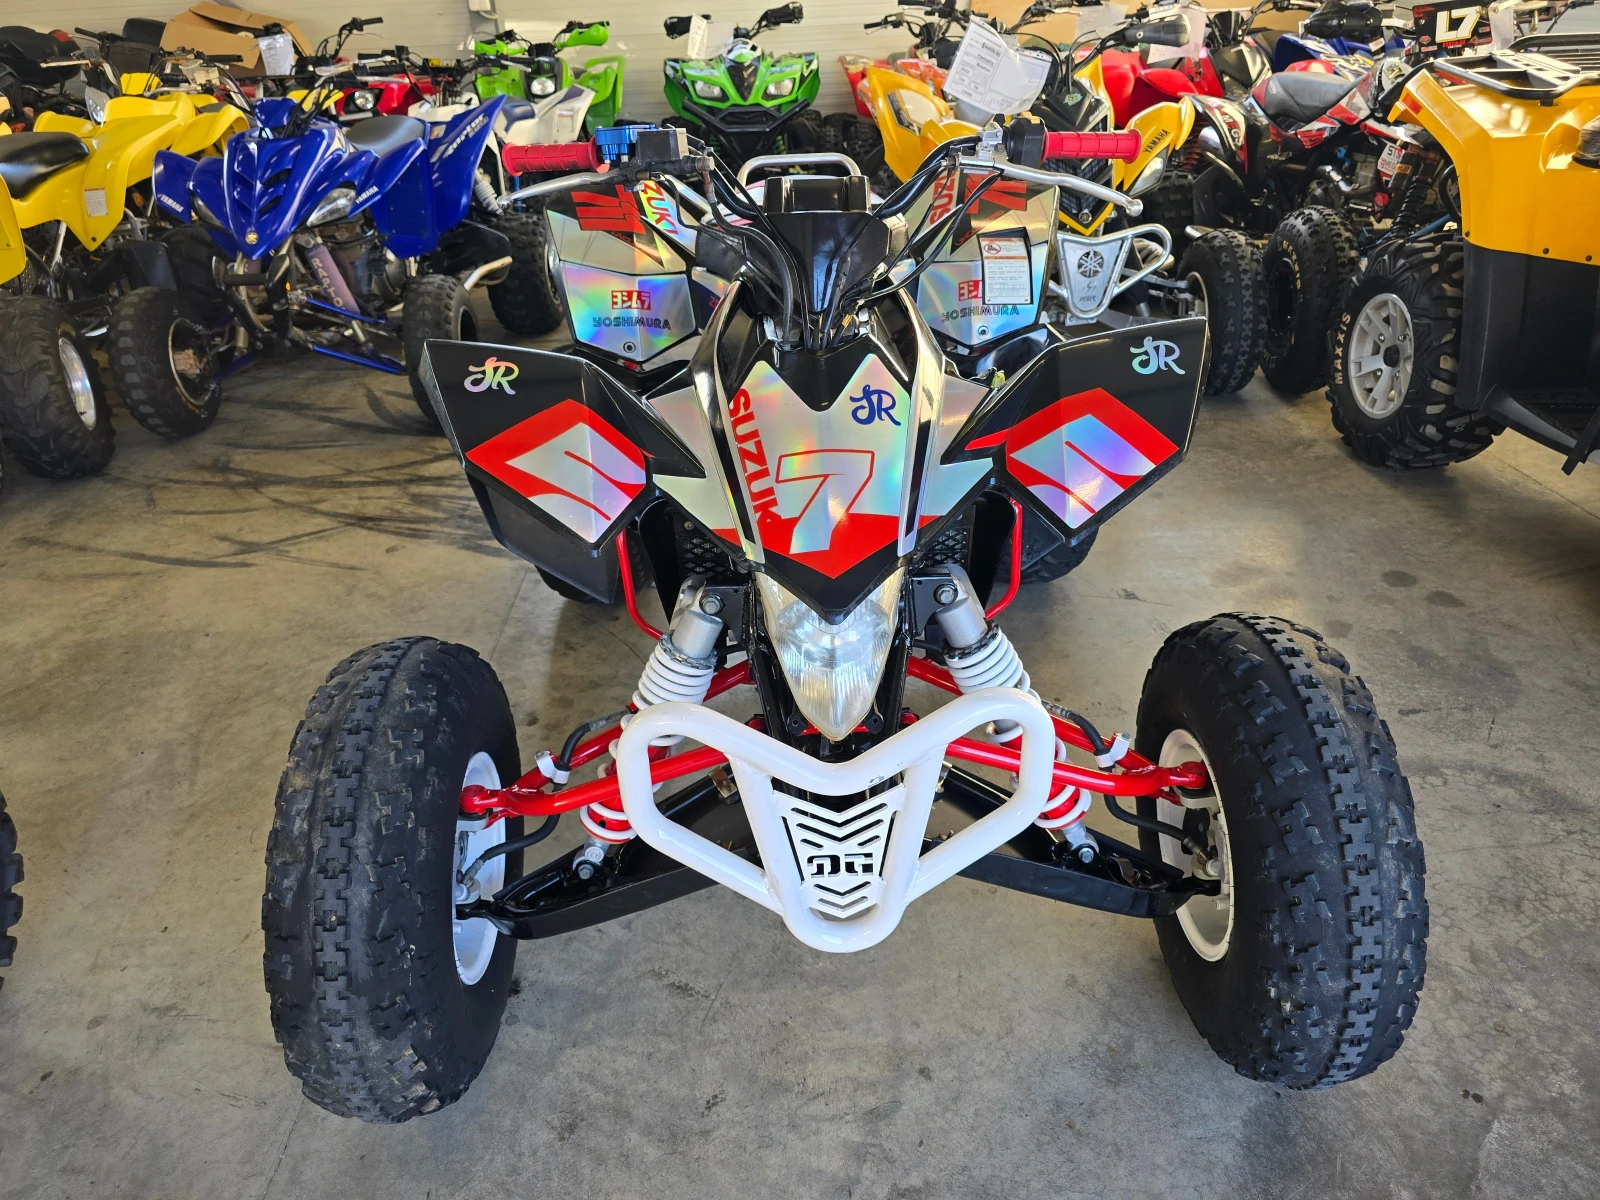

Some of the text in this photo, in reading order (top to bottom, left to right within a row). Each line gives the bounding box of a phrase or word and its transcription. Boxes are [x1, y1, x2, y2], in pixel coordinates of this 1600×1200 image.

[1143, 129, 1170, 154] YAMAHA
[158, 193, 184, 213] YAMAHA
[355, 185, 380, 205] YAMAHA
[643, 181, 680, 236] ZUKI
[311, 257, 344, 309] RAPTO
[612, 291, 651, 310] ヨシムラ
[959, 281, 982, 301] ヨシ
[592, 316, 671, 331] YOSHIMURA
[941, 305, 1020, 322] YOSHIMURA
[1130, 336, 1185, 375] JR
[1333, 311, 1351, 385] MAXXIS
[464, 356, 519, 395] JR
[849, 384, 901, 426] JR
[728, 388, 783, 524] SUZUK
[775, 448, 875, 555] 7
